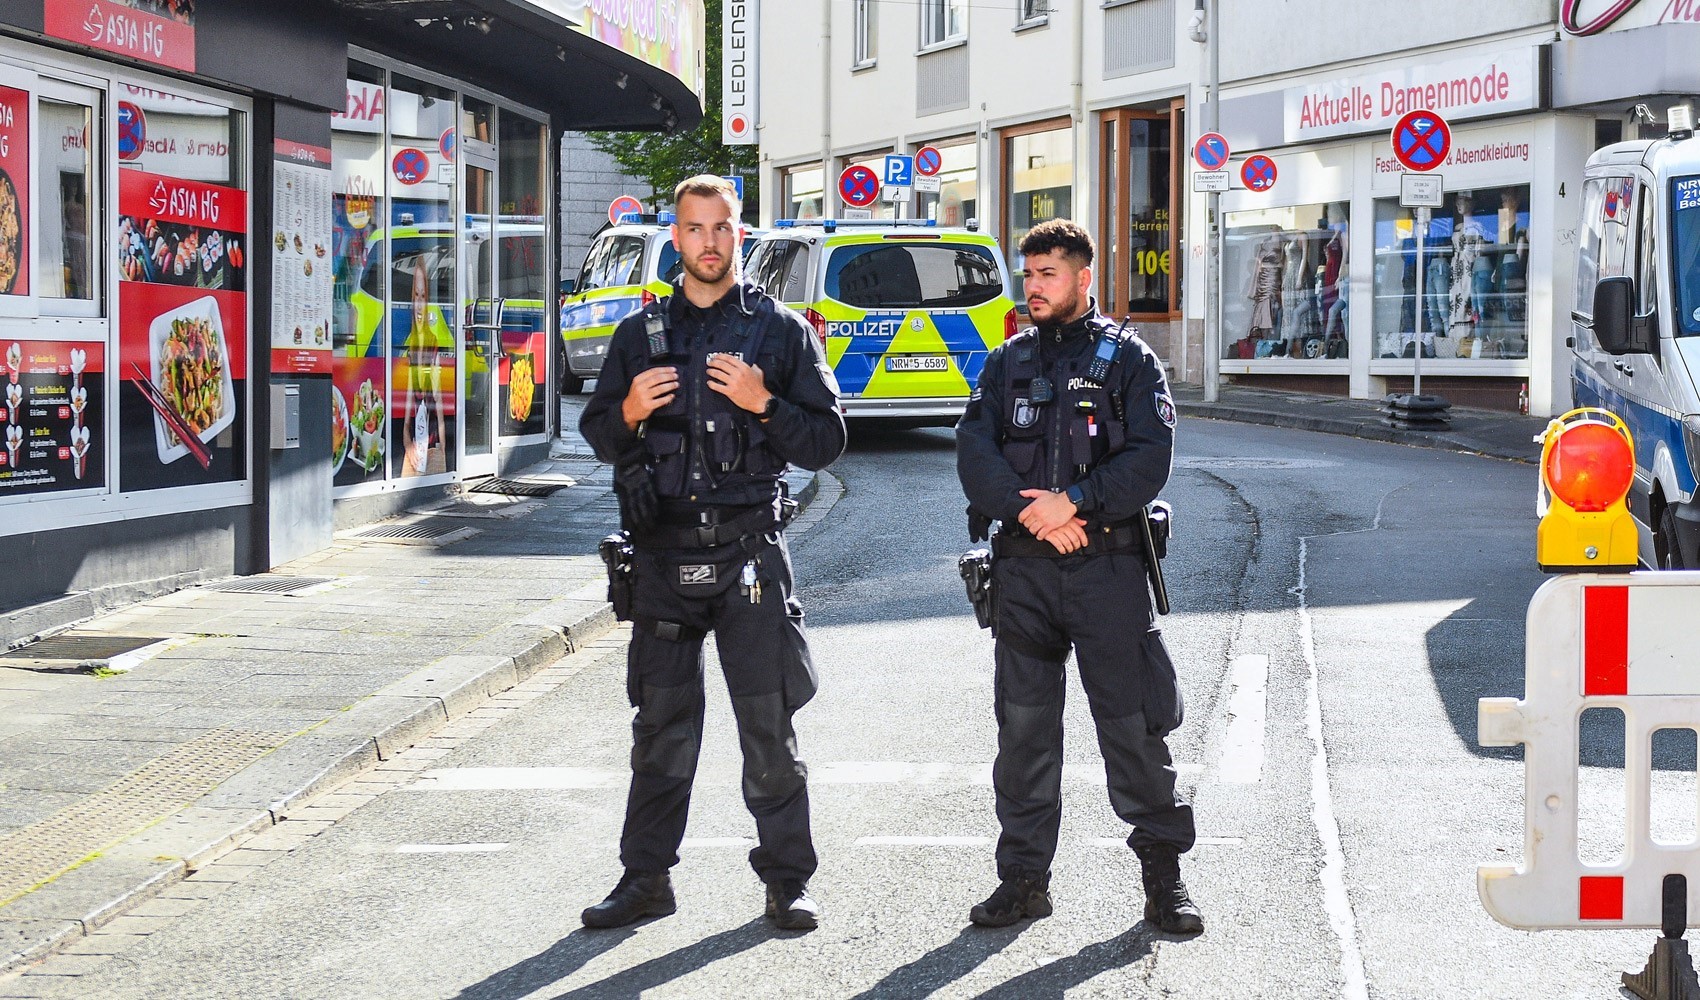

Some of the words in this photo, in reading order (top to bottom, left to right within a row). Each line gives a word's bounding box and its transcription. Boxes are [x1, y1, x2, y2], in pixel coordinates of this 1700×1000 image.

[107, 14, 138, 49] ASIA
[143, 21, 163, 58] HG
[732, 0, 745, 107] LEDLENS
[1300, 86, 1372, 129] Aktuelle
[1381, 64, 1509, 118] Damenmode
[1455, 141, 1529, 165] Abendkleidung
[888, 159, 905, 182] P
[1558, 182, 1566, 198] 4
[1678, 179, 1700, 191] NR
[1683, 189, 1700, 200] 21
[169, 189, 197, 216] ASIA
[201, 191, 220, 224] HG
[1032, 193, 1055, 219] Ekin
[1136, 250, 1170, 275] 10€
[827, 321, 894, 337] POLIZEI
[914, 357, 947, 369] 5-6589
